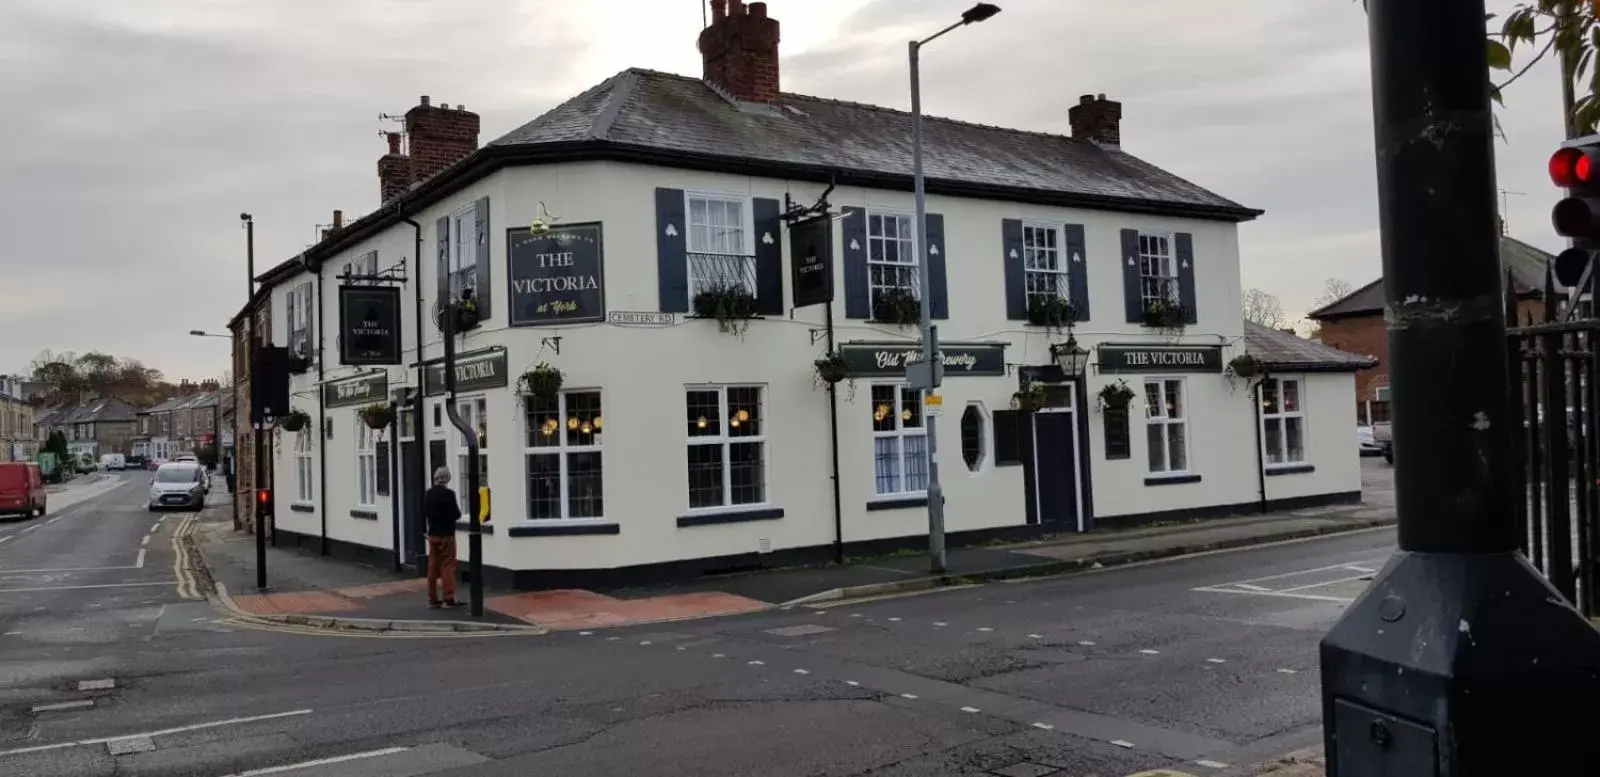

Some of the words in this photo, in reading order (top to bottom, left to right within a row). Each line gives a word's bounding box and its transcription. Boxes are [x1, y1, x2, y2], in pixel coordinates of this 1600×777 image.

[535, 252, 574, 268] THE
[513, 275, 598, 293] VICTORIA
[536, 303, 548, 313] at
[549, 300, 577, 315] York
[362, 320, 379, 328] THE
[611, 313, 656, 322] CEMETERY
[659, 314, 672, 323] RD
[352, 328, 390, 336] VICTORIA
[875, 351, 899, 368] Old
[1124, 352, 1149, 365] THE
[1150, 352, 1205, 365] VICTORIA
[454, 360, 496, 382] VICTORIA
